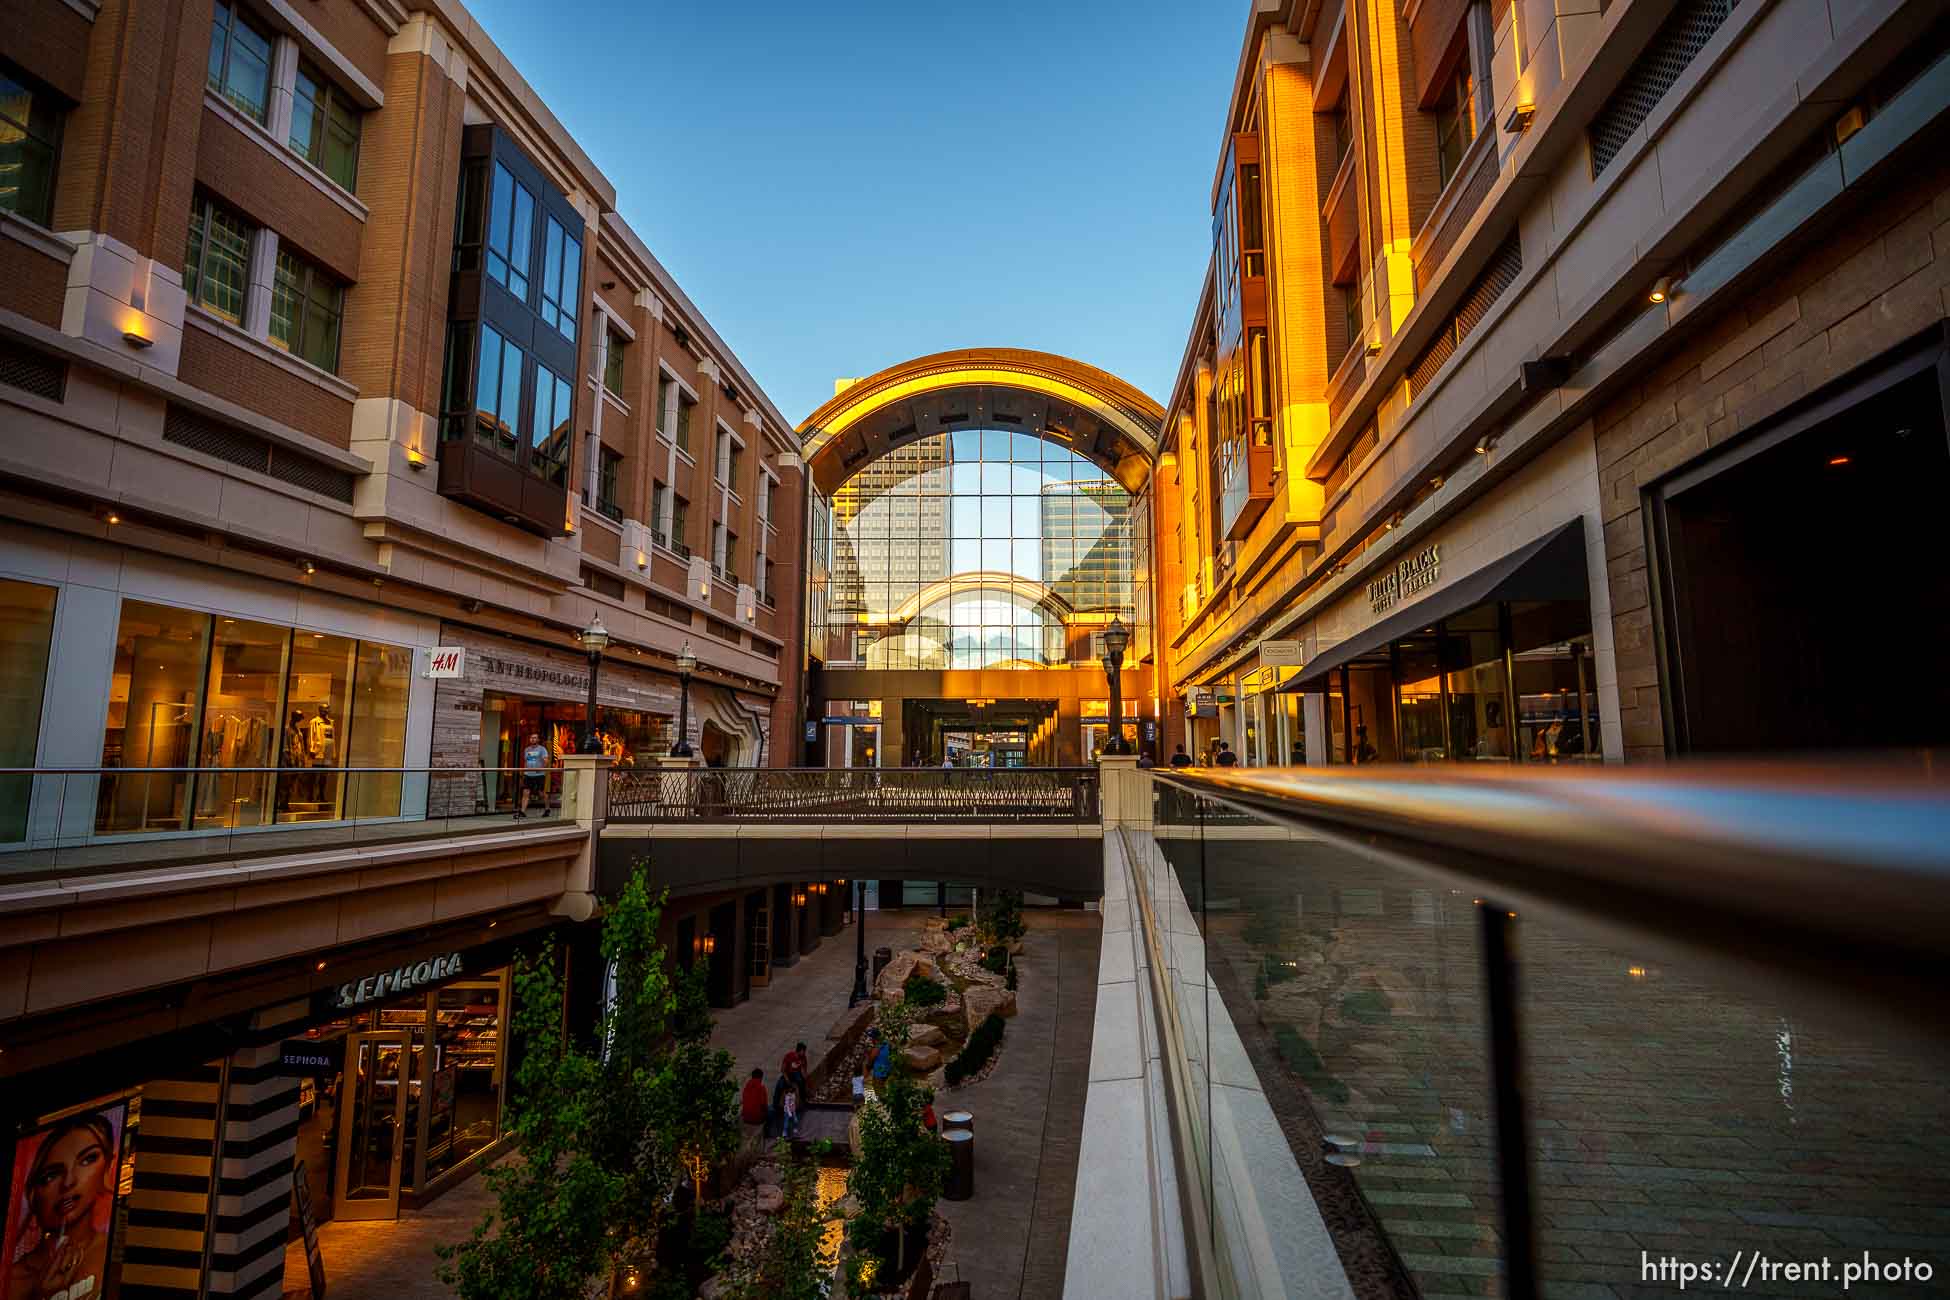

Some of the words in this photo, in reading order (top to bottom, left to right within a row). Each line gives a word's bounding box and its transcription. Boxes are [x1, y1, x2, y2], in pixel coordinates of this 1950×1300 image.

[431, 652, 459, 672] H&M
[486, 658, 591, 690] ANTHROPOLOGIE
[336, 952, 464, 1008] SEPHORA
[283, 1055, 330, 1066] SEPHORA
